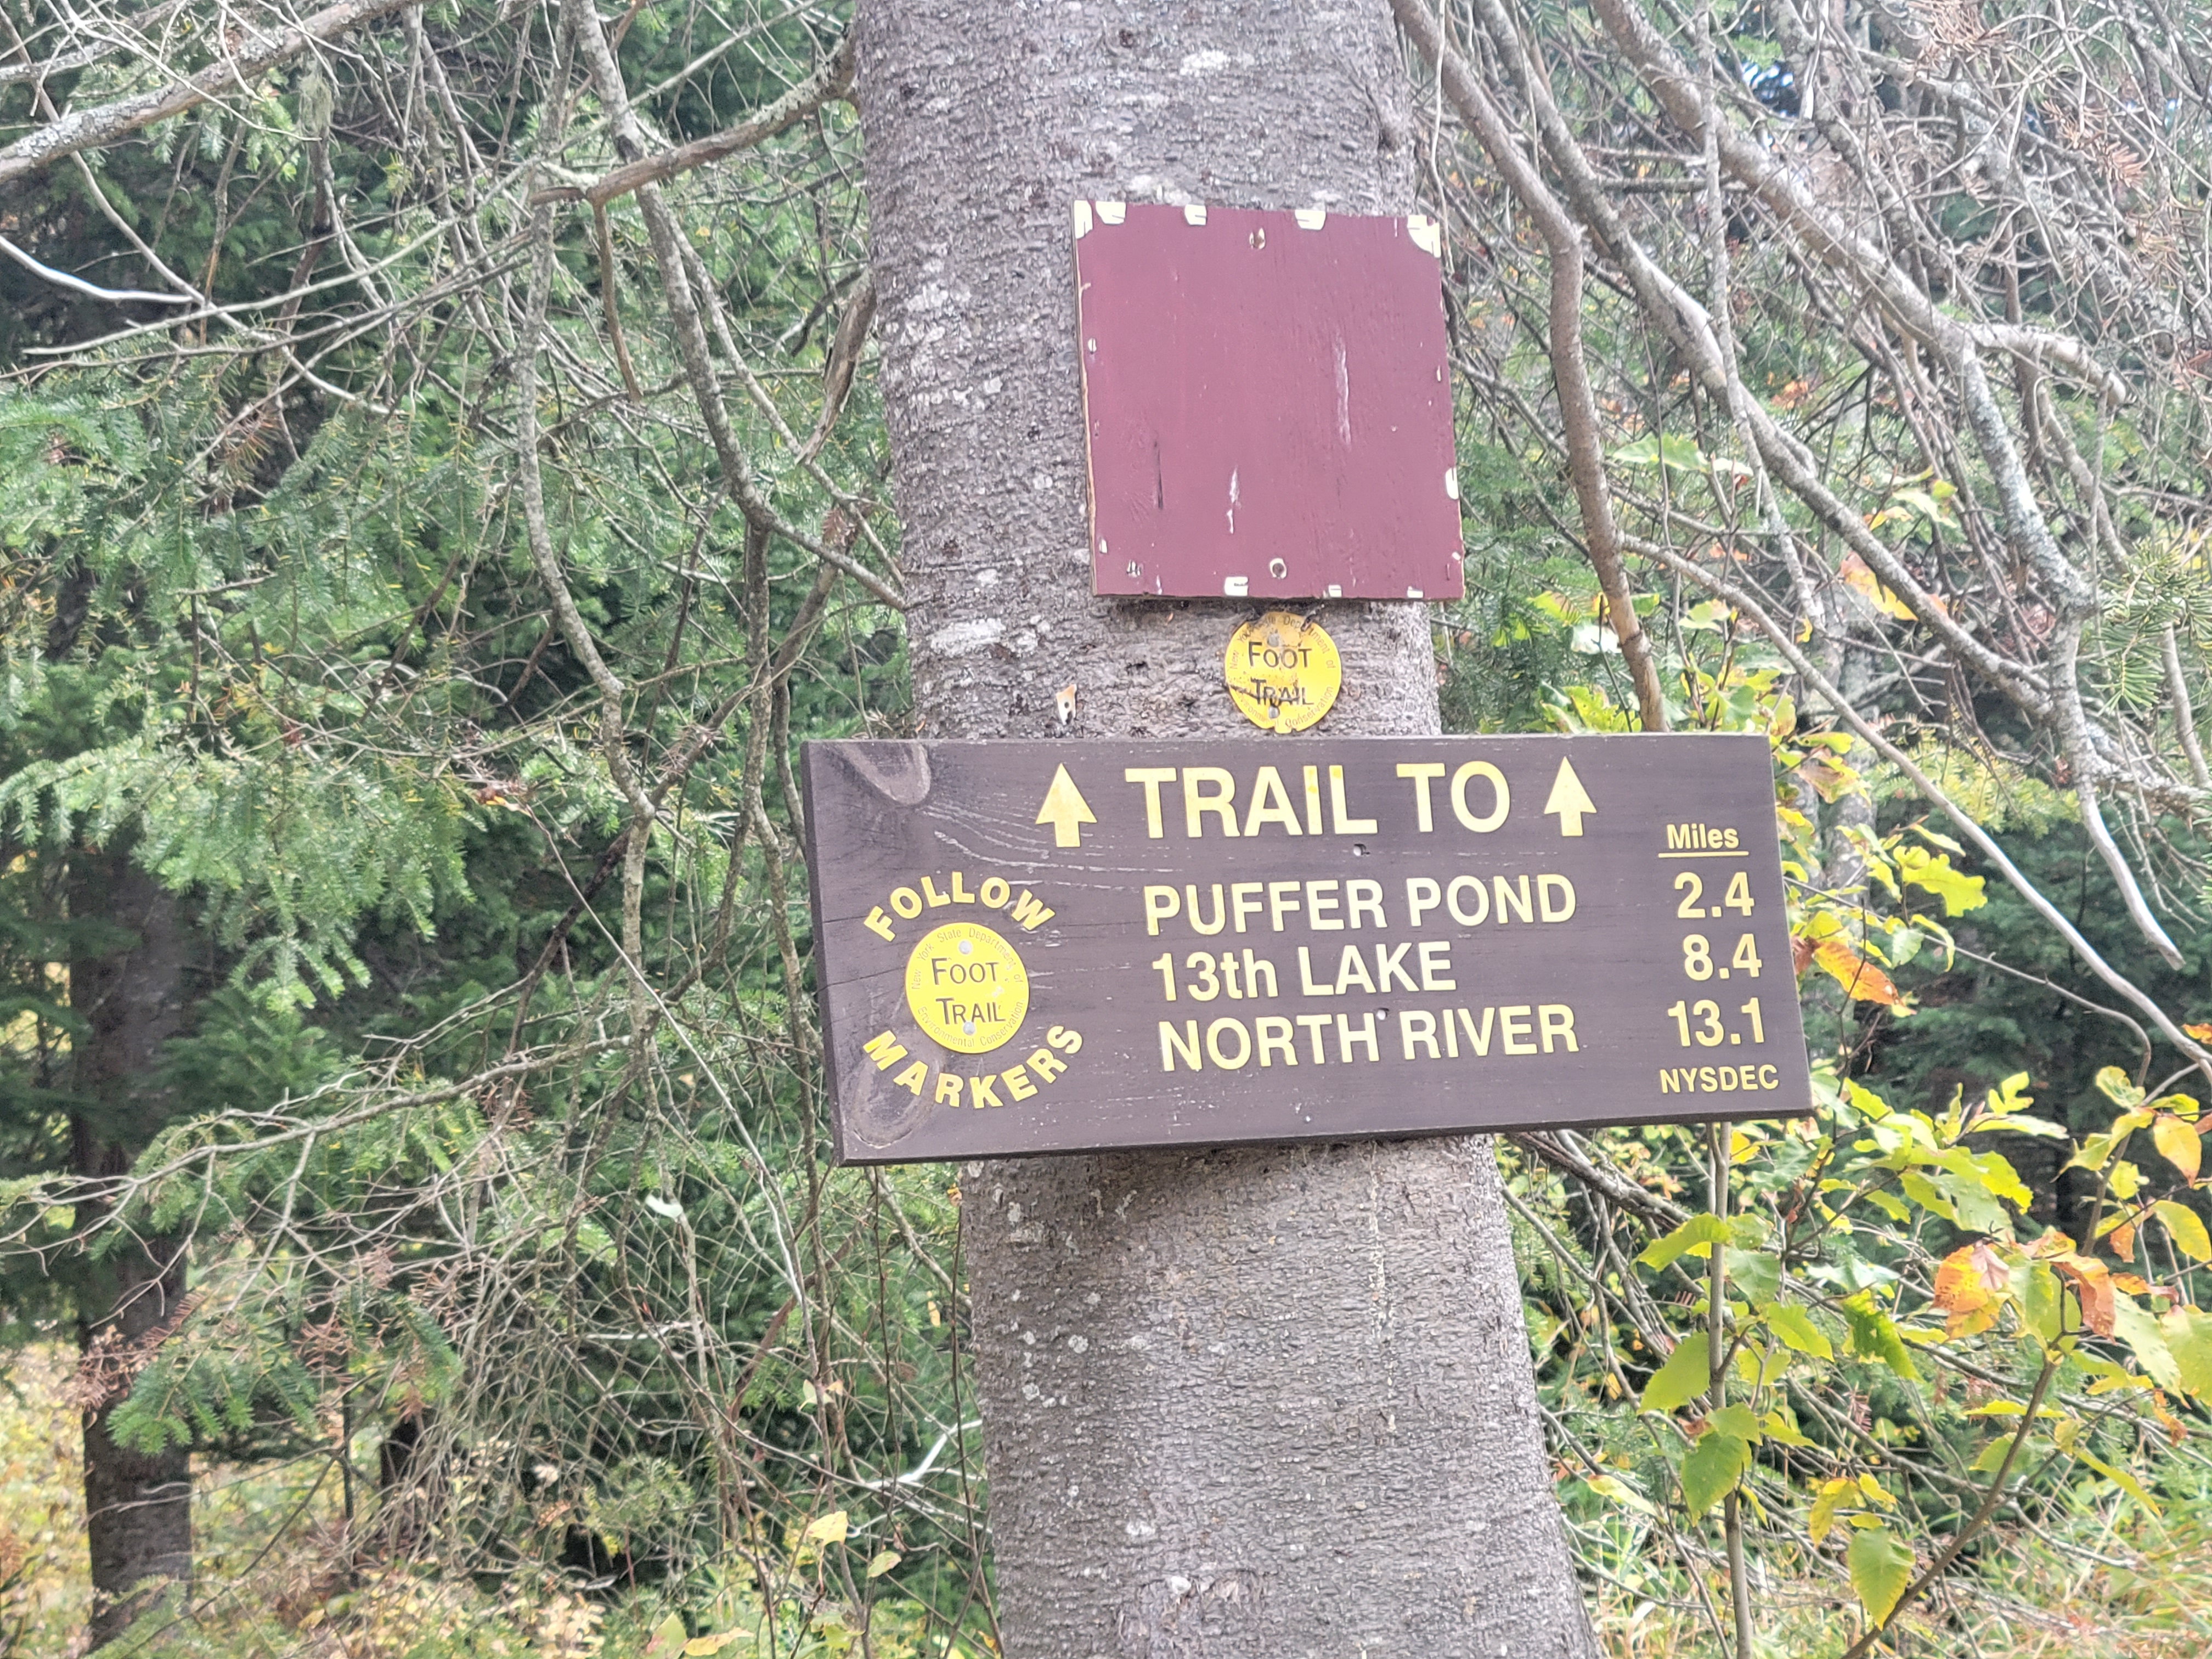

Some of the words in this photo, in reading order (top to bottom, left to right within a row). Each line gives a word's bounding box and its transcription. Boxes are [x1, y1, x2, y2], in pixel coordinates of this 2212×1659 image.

[1248, 641, 1312, 669] FOOT
[1125, 764, 1378, 839] TRAIL
[1396, 760, 1511, 833] TO
[1667, 823, 1739, 849] Miles
[864, 871, 1056, 942] FOLLOW
[1144, 878, 1387, 936] PUFFER
[1406, 874, 1577, 927] POND
[1674, 872, 1754, 918] 2.4
[911, 969, 921, 990] New
[918, 943, 934, 961] York
[937, 928, 962, 943] State
[1013, 974, 1024, 984] of
[931, 957, 999, 985] FOOT
[1152, 948, 1278, 1001] 13th
[1297, 940, 1457, 996] LAKE
[1683, 933, 1762, 980] 8.4
[917, 1006, 974, 1047] Environmental
[980, 1001, 1024, 1046] Conservation
[935, 997, 1006, 1025] TRAIL
[1667, 997, 1764, 1047] 13.1
[1159, 1012, 1381, 1072] NORTH
[1399, 1004, 1579, 1061] RIVER
[863, 1025, 1083, 1109] MARKERS
[1660, 1064, 1779, 1093] NYSDEC
